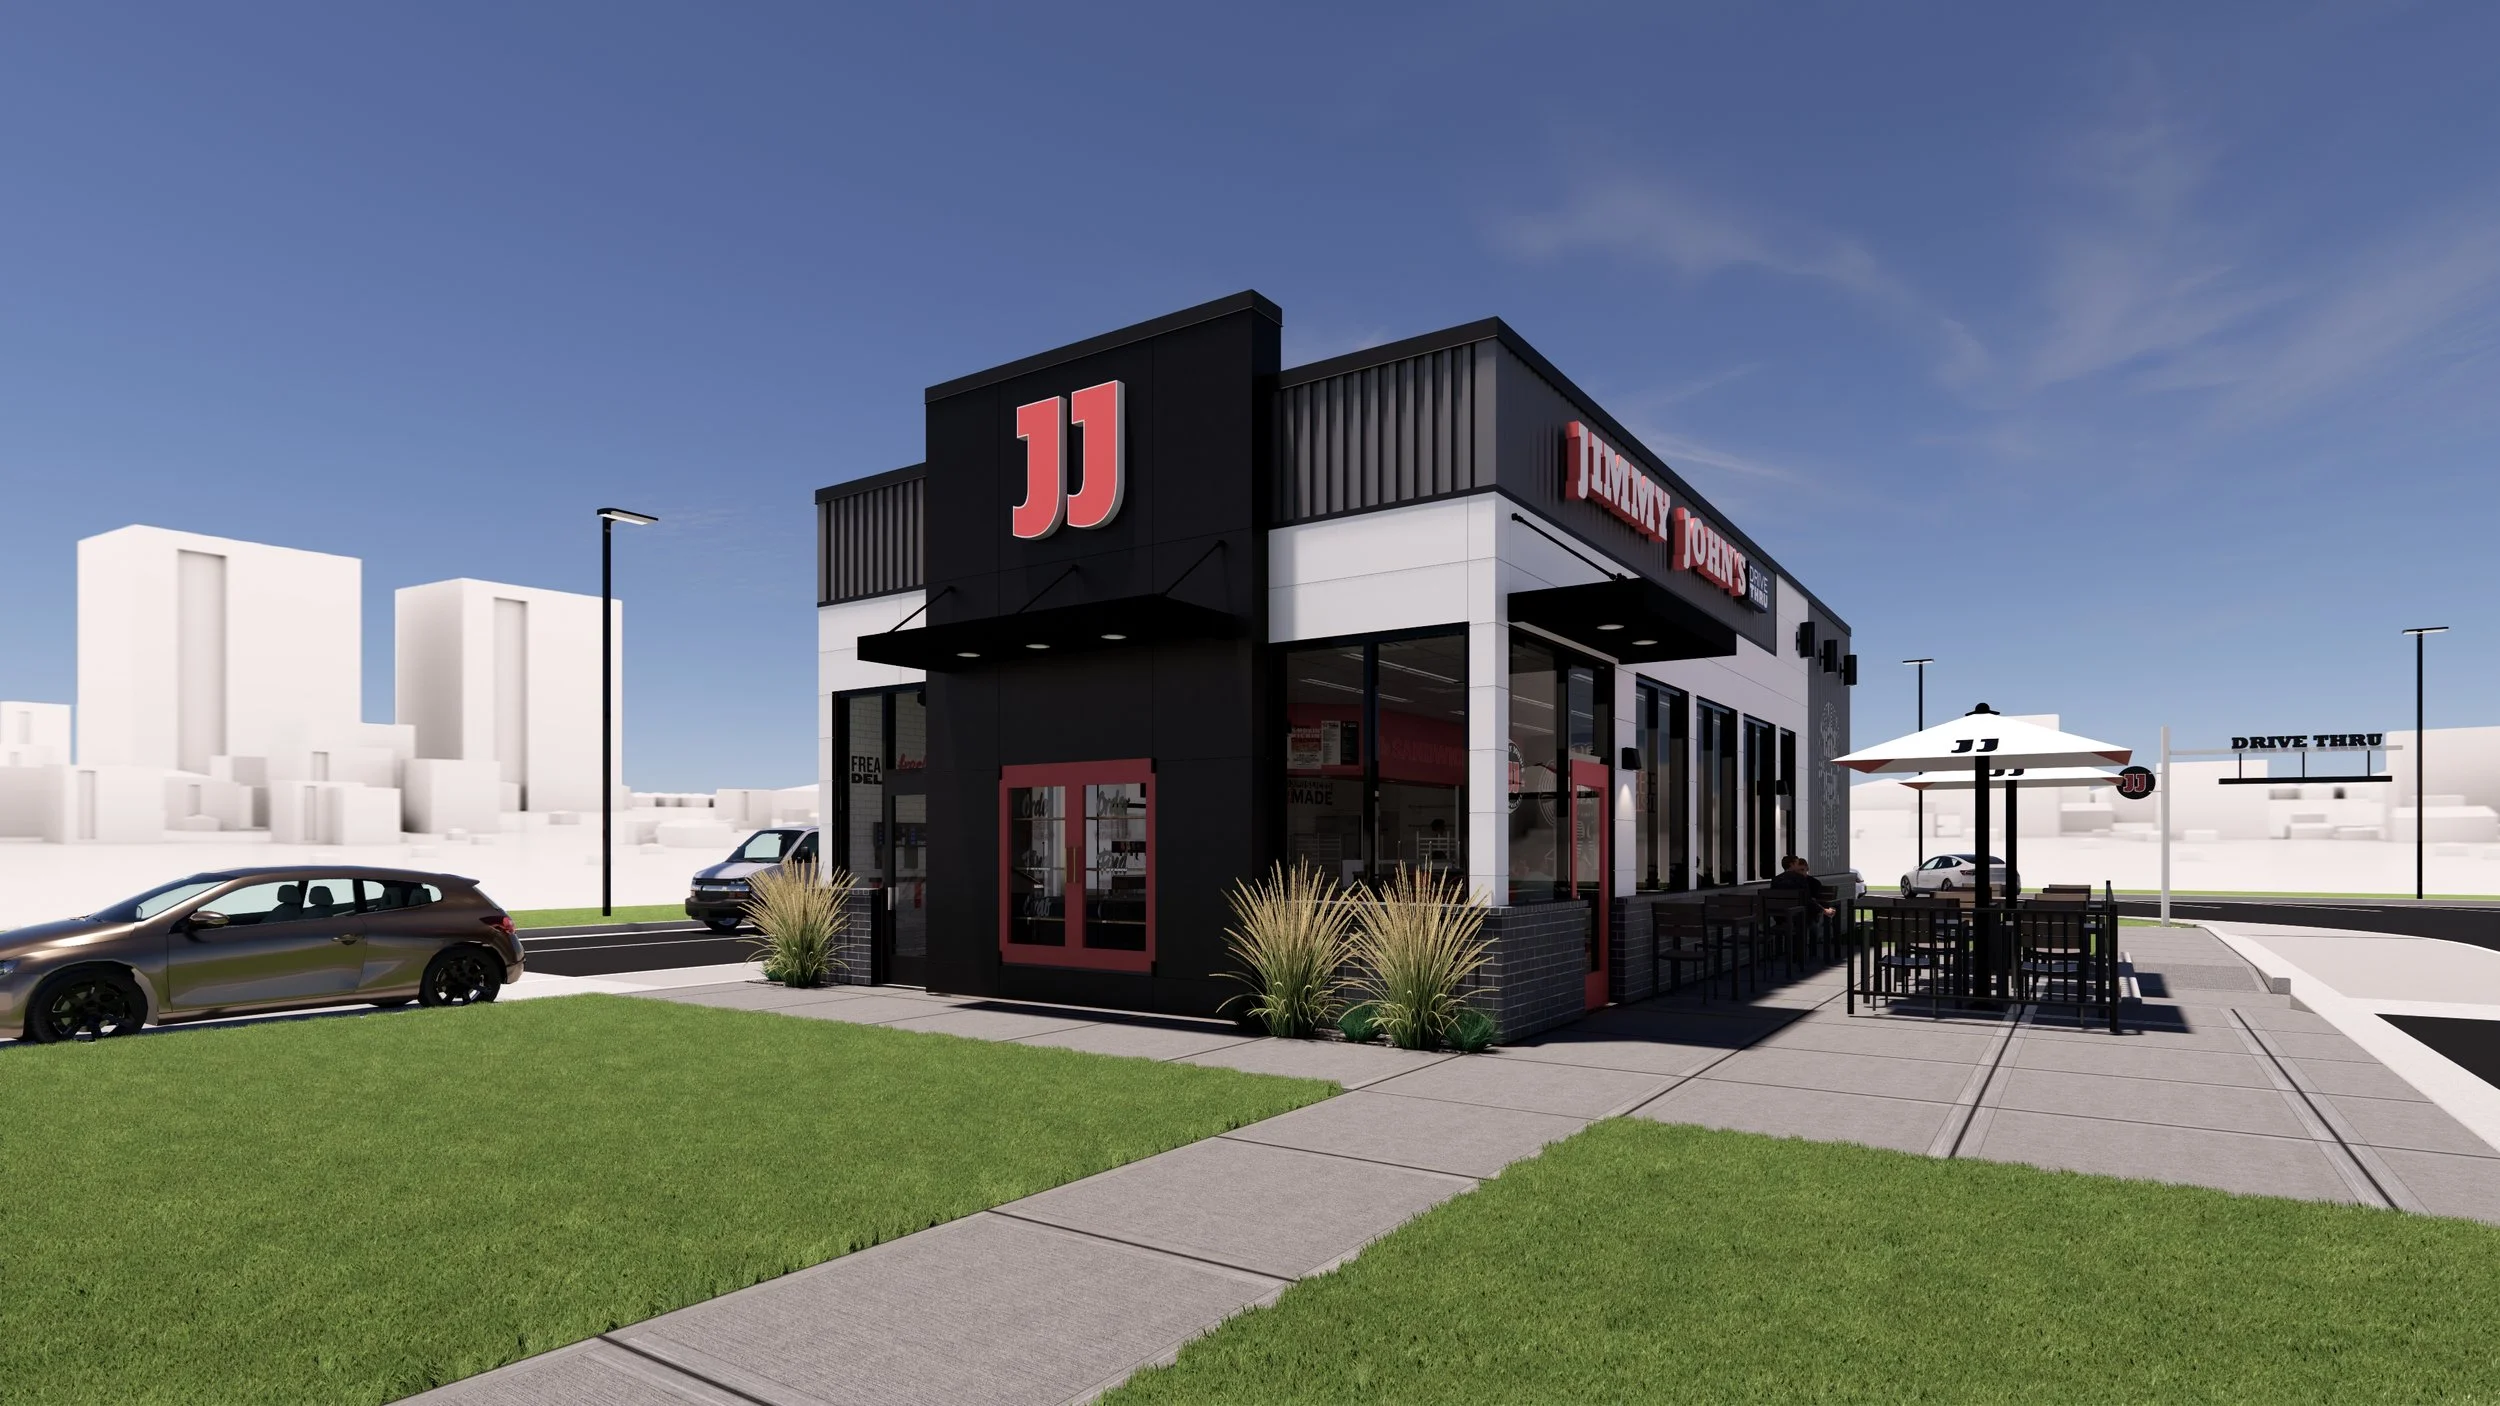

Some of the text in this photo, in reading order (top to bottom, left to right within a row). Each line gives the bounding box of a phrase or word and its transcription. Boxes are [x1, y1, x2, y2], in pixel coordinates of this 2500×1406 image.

[1012, 380, 1125, 540] JJ
[1570, 420, 1747, 596] JIMMY JOHN'S
[1749, 565, 1769, 593] DRIVE
[1749, 583, 1769, 608] THRU
[1951, 738, 1999, 753] JJ
[2231, 733, 2383, 749] DRIVE THRU
[851, 756, 881, 773] FREA
[2123, 774, 2146, 793] JJ
[1290, 789, 1333, 806] MADE
